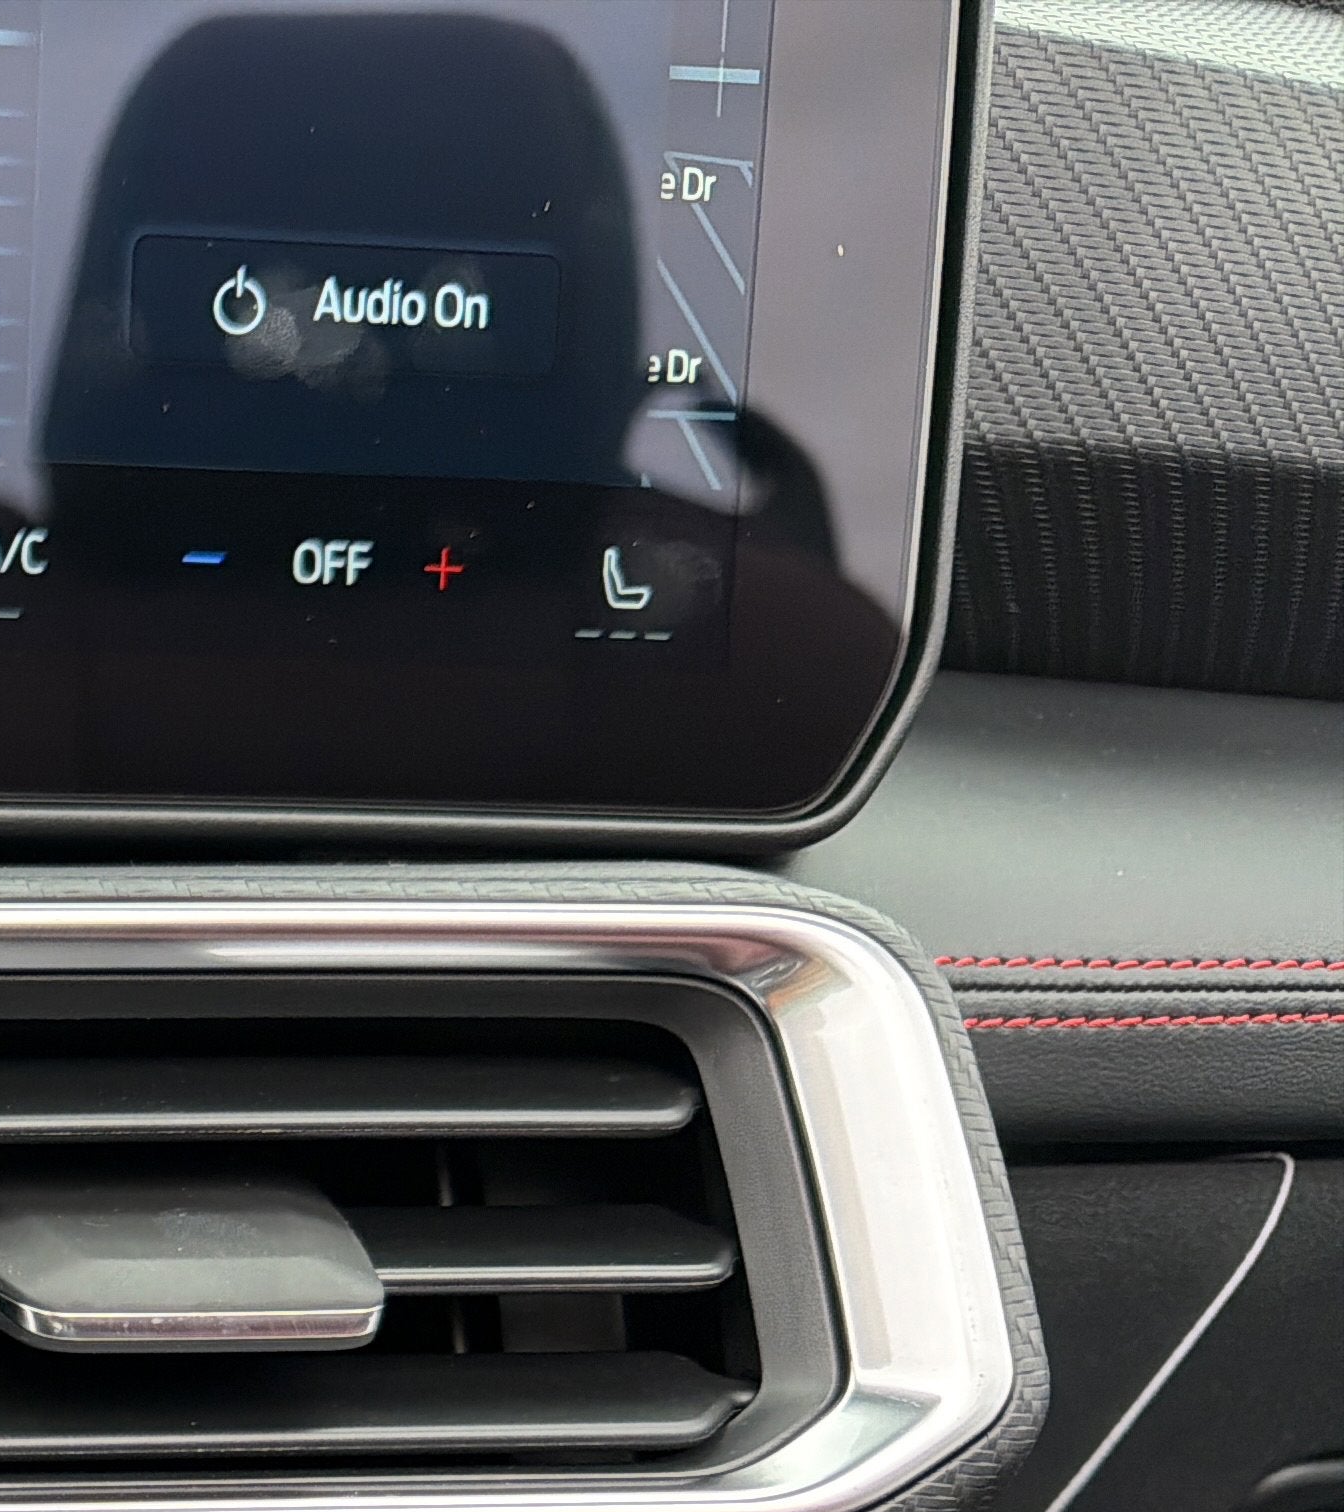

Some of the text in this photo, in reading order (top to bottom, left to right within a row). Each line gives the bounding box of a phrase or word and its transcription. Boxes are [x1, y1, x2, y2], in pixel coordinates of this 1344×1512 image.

[682, 167, 716, 201] Dr
[313, 275, 490, 330] Audio On
[667, 349, 702, 384] Dr
[292, 540, 373, 586] OFF
